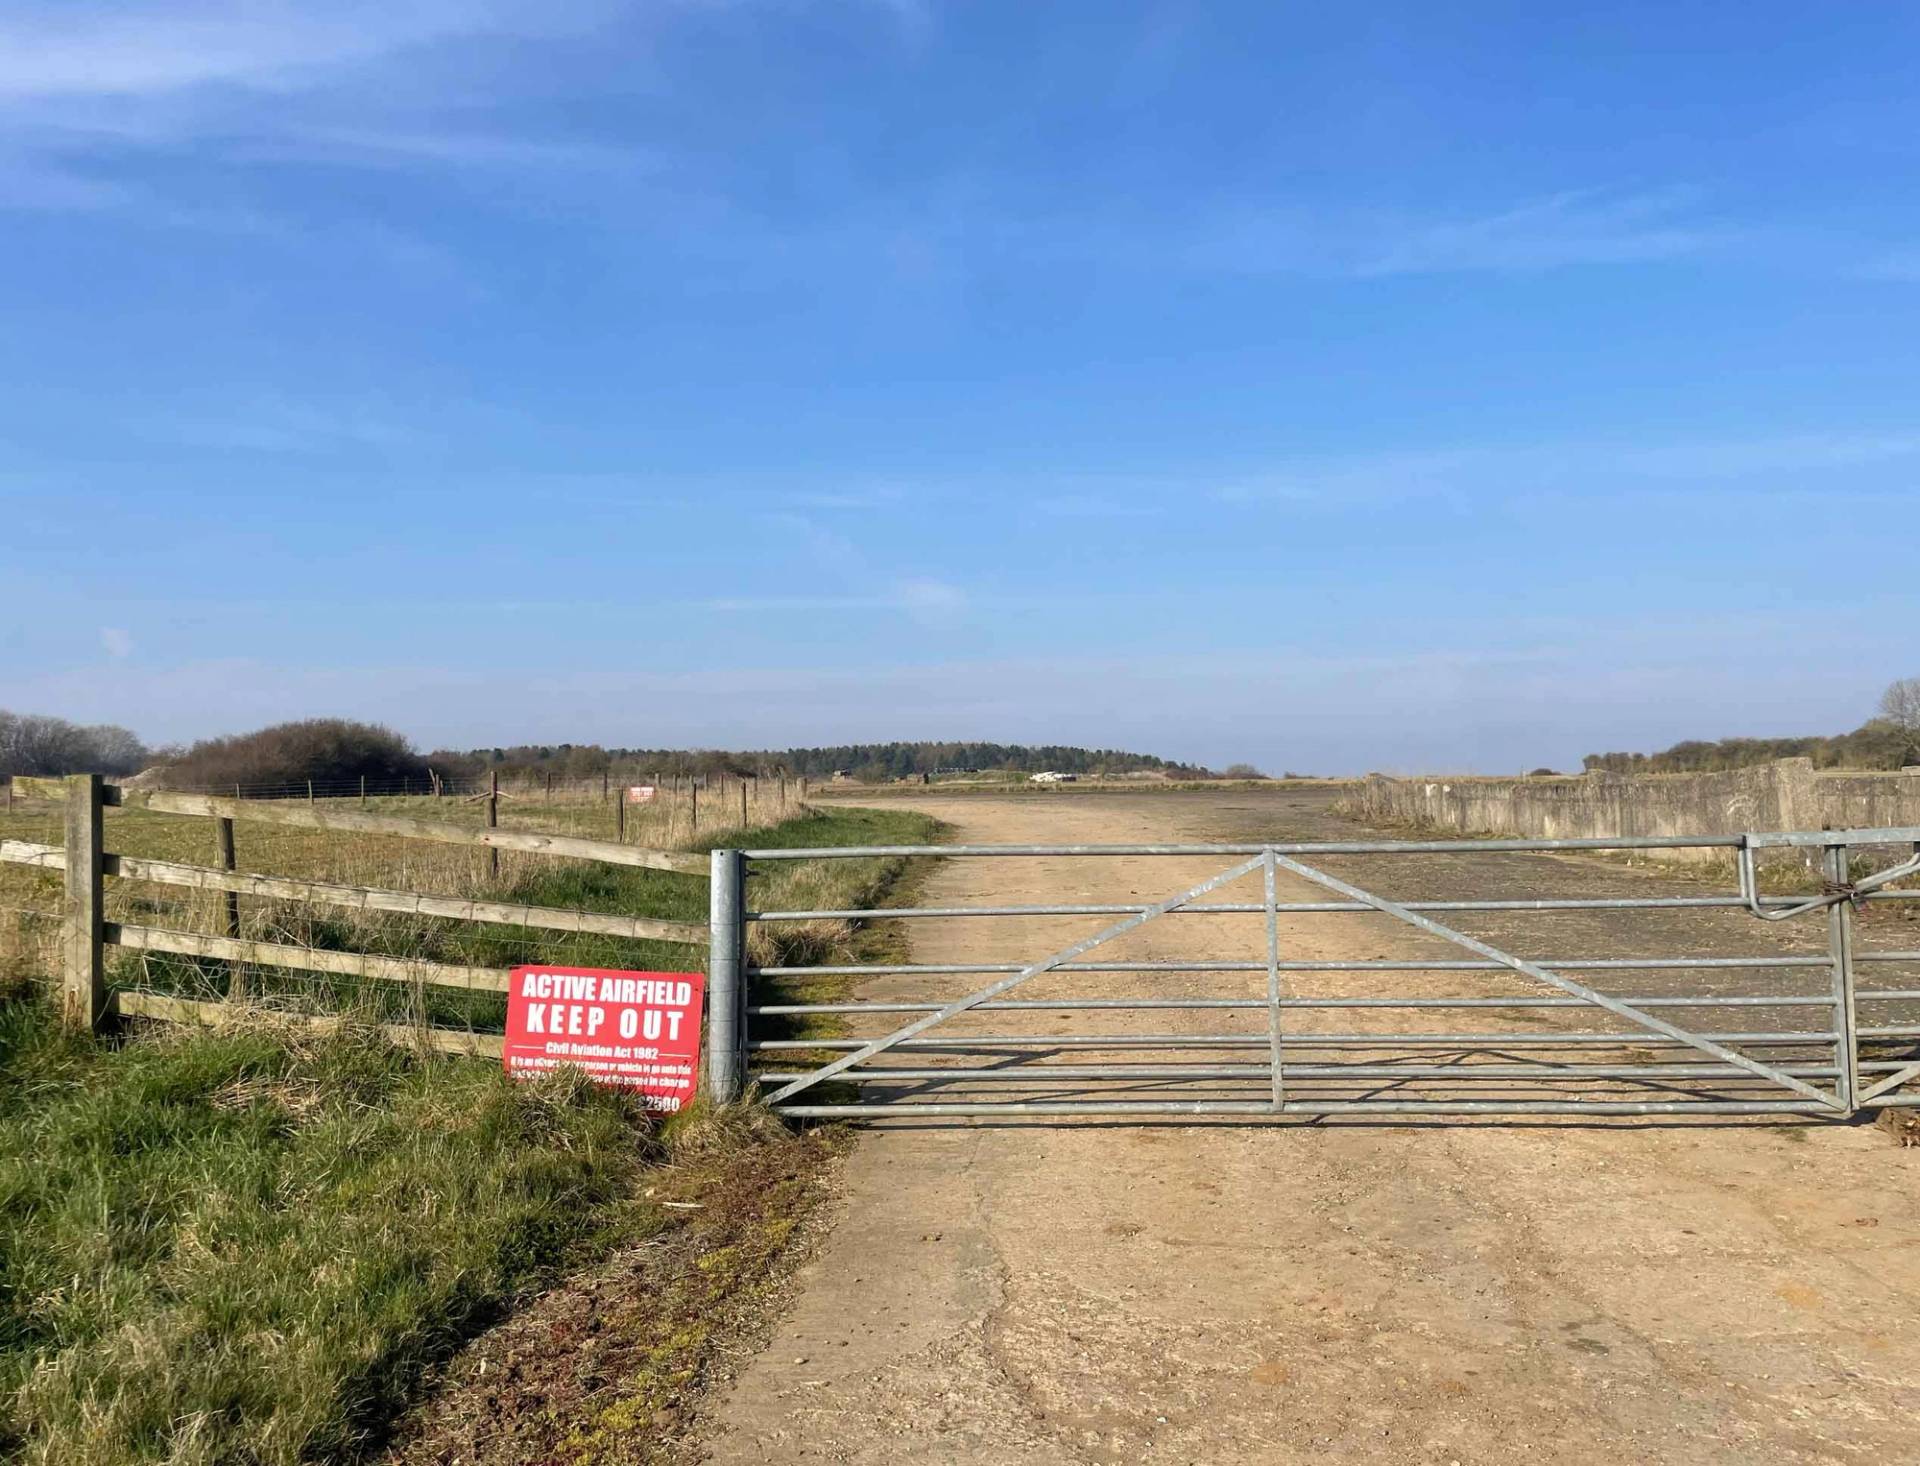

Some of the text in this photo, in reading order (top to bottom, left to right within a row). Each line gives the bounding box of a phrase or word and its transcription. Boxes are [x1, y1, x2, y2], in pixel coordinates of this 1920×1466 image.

[522, 973, 691, 1006] ACTIVE AIRFIELD
[526, 1003, 684, 1041] KEEP OUT
[546, 1041, 659, 1060] Civil Aviation Act 1982
[649, 1076, 658, 1086] in
[659, 1077, 690, 1089] charge
